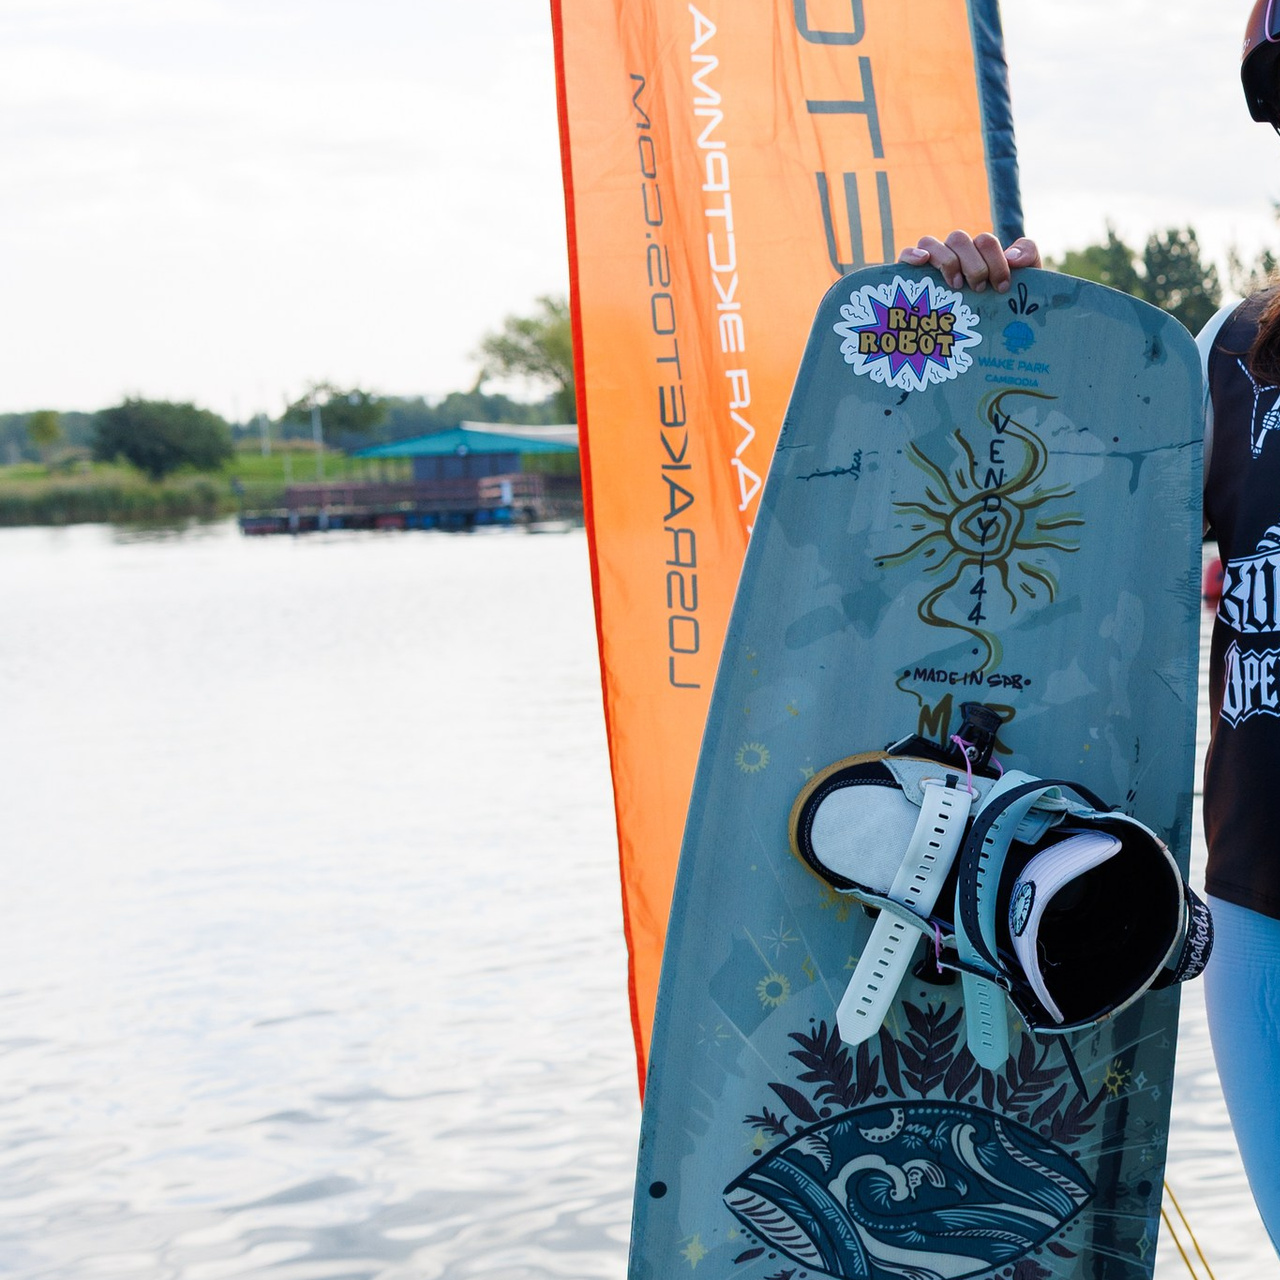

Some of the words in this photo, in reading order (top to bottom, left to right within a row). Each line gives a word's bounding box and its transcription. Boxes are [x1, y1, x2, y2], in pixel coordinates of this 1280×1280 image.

[887, 307, 956, 332] Ride
[978, 356, 1015, 371] WAKE
[1017, 359, 1051, 374] PARK
[984, 373, 1039, 388] CAMBODIA
[963, 670, 984, 686] IN
